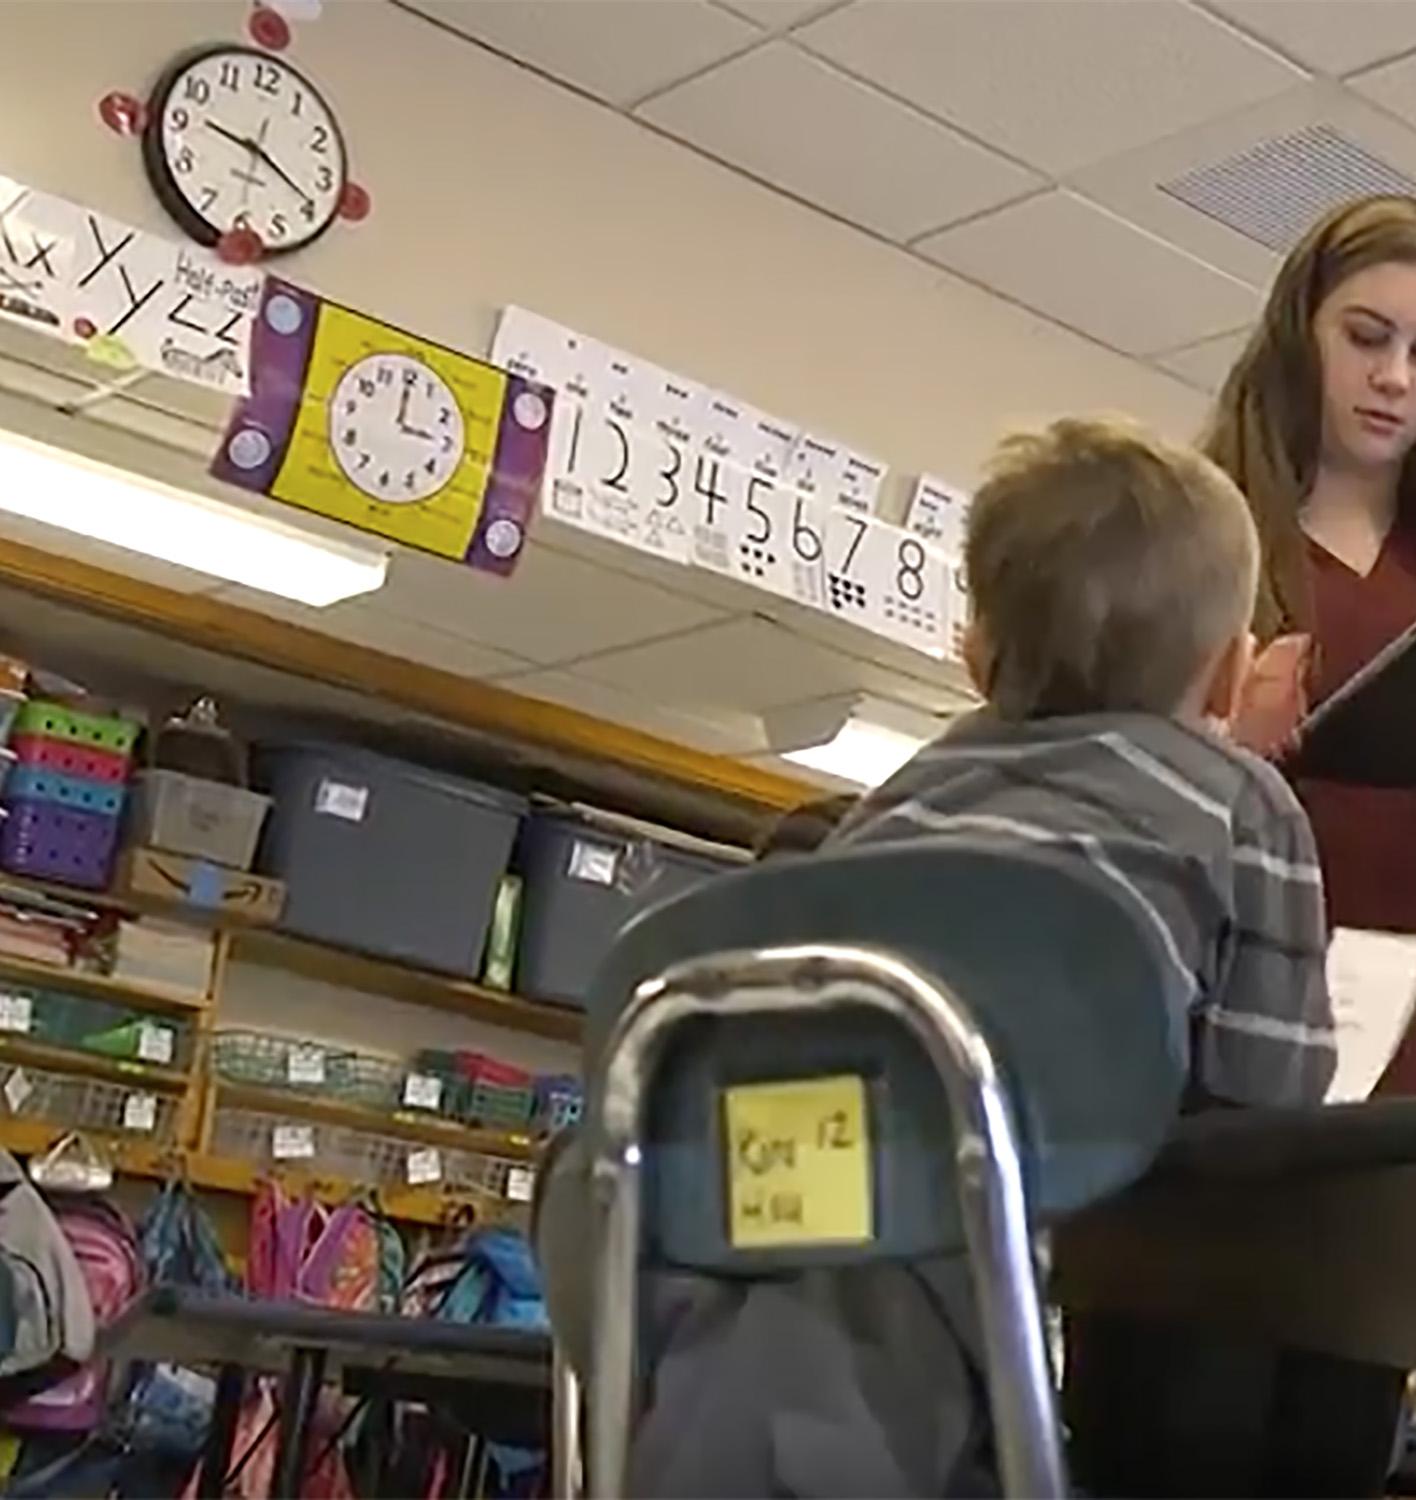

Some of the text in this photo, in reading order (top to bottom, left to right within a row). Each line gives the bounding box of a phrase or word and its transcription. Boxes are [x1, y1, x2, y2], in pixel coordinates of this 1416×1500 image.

[183, 74, 211, 106] 10
[218, 61, 240, 93] 11
[253, 62, 282, 96] 12
[290, 89, 302, 117] 1
[170, 107, 189, 132] 9
[309, 124, 329, 154] 2
[174, 146, 195, 175] 8
[314, 165, 333, 193] 3
[199, 186, 218, 213] 7
[299, 198, 316, 223] 4
[267, 213, 288, 240] 5
[358, 377, 376, 398] 10
[567, 402, 584, 474] 1
[599, 417, 630, 493] 2
[655, 439, 683, 508] 3
[693, 455, 729, 525] 4
[746, 475, 775, 545] 5
[792, 496, 823, 562] 6
[840, 515, 869, 575] 7
[897, 537, 926, 601] 8
